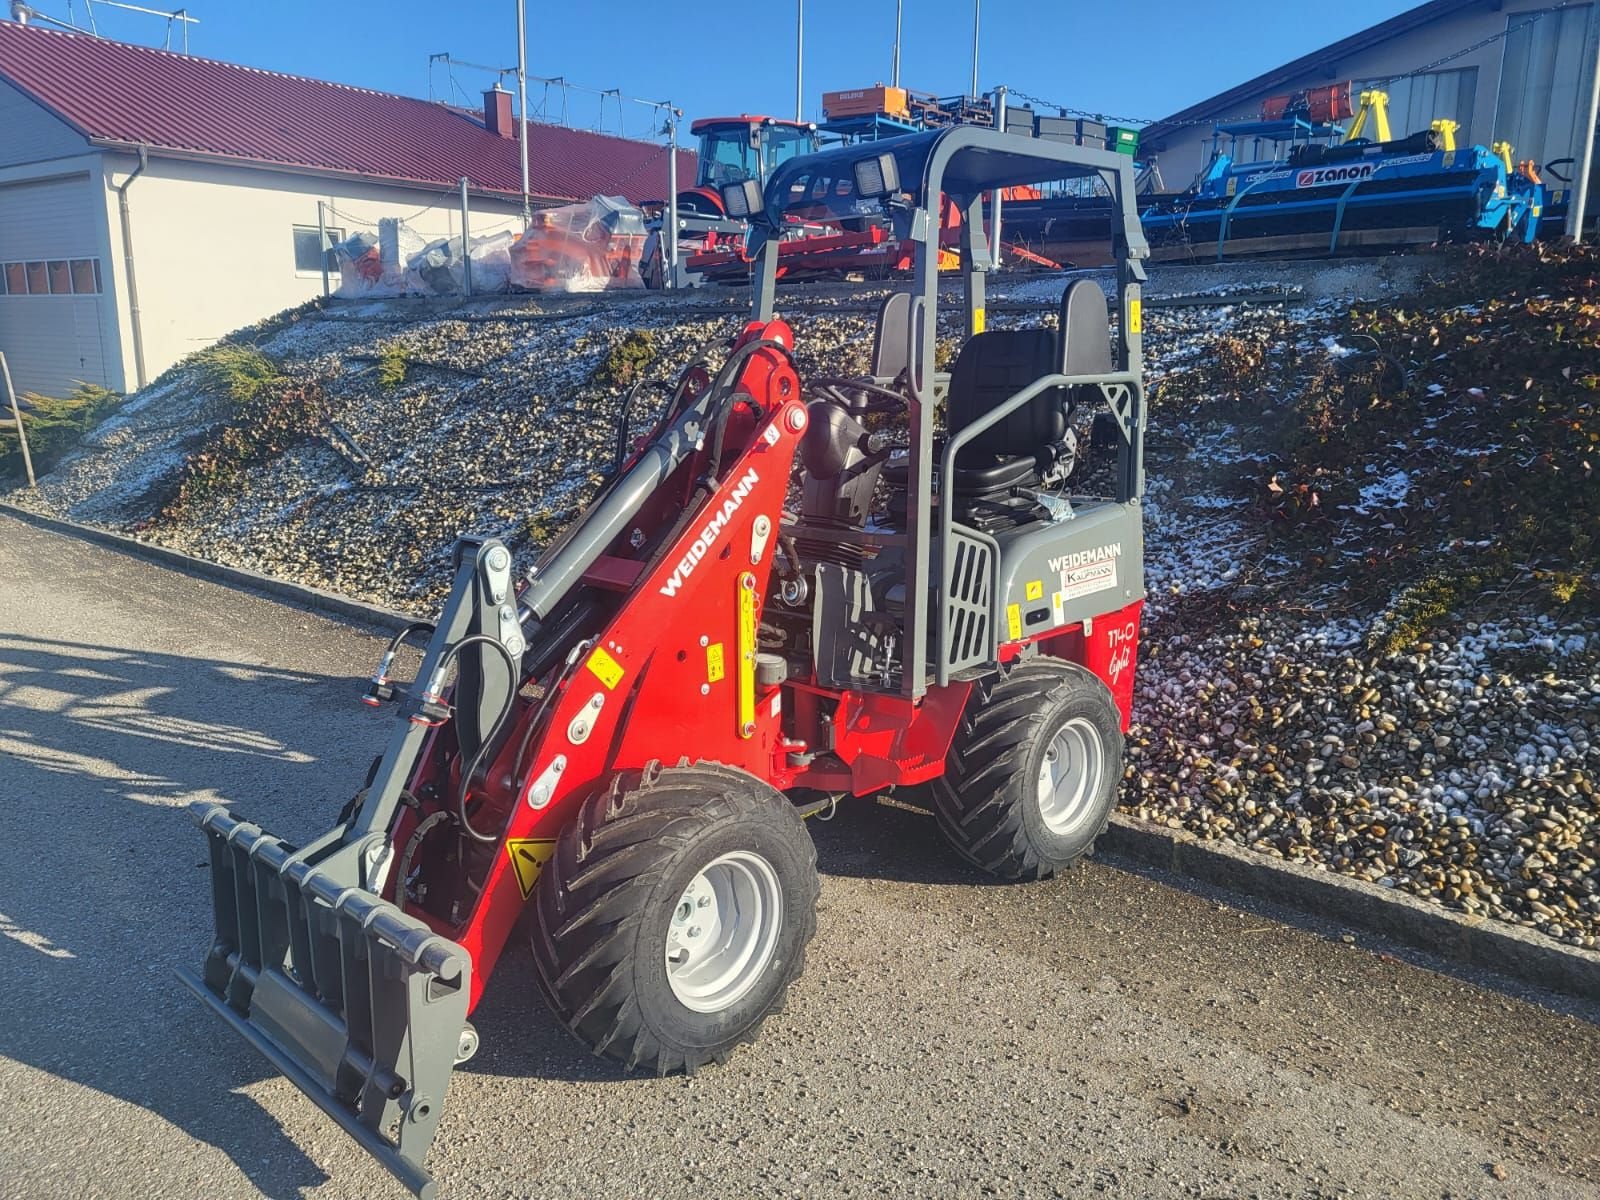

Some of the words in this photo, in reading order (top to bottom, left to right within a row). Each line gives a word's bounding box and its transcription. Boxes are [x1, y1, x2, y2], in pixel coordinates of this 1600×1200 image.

[659, 467, 760, 598] WEIDEMANN
[1047, 541, 1121, 573] WEIDEMANN
[1108, 621, 1135, 649] 1140
